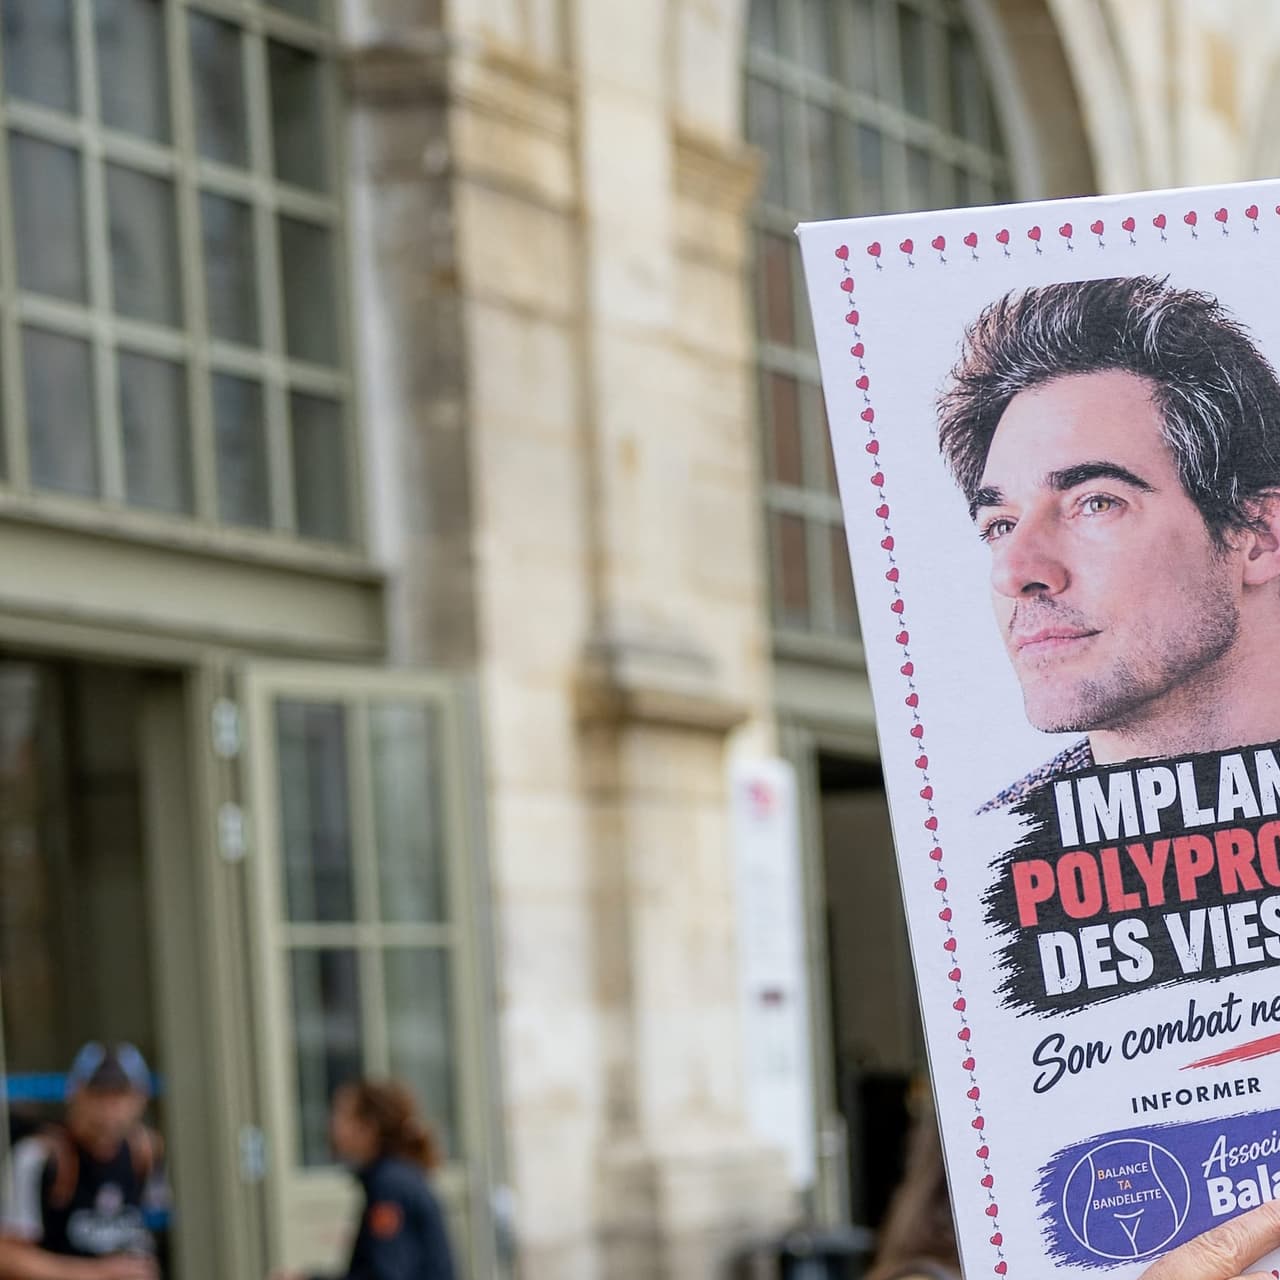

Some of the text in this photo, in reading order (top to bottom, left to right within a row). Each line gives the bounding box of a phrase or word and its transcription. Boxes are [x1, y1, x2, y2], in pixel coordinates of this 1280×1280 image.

[1037, 916, 1156, 998] DES
[1032, 1032, 1112, 1094] Son
[1120, 997, 1242, 1060] combat
[1131, 1076, 1262, 1114] INFORMER
[1097, 1162, 1149, 1180] BALANCE
[1117, 1180, 1132, 1191] TA
[1093, 1188, 1162, 1210] BANDELETTE
